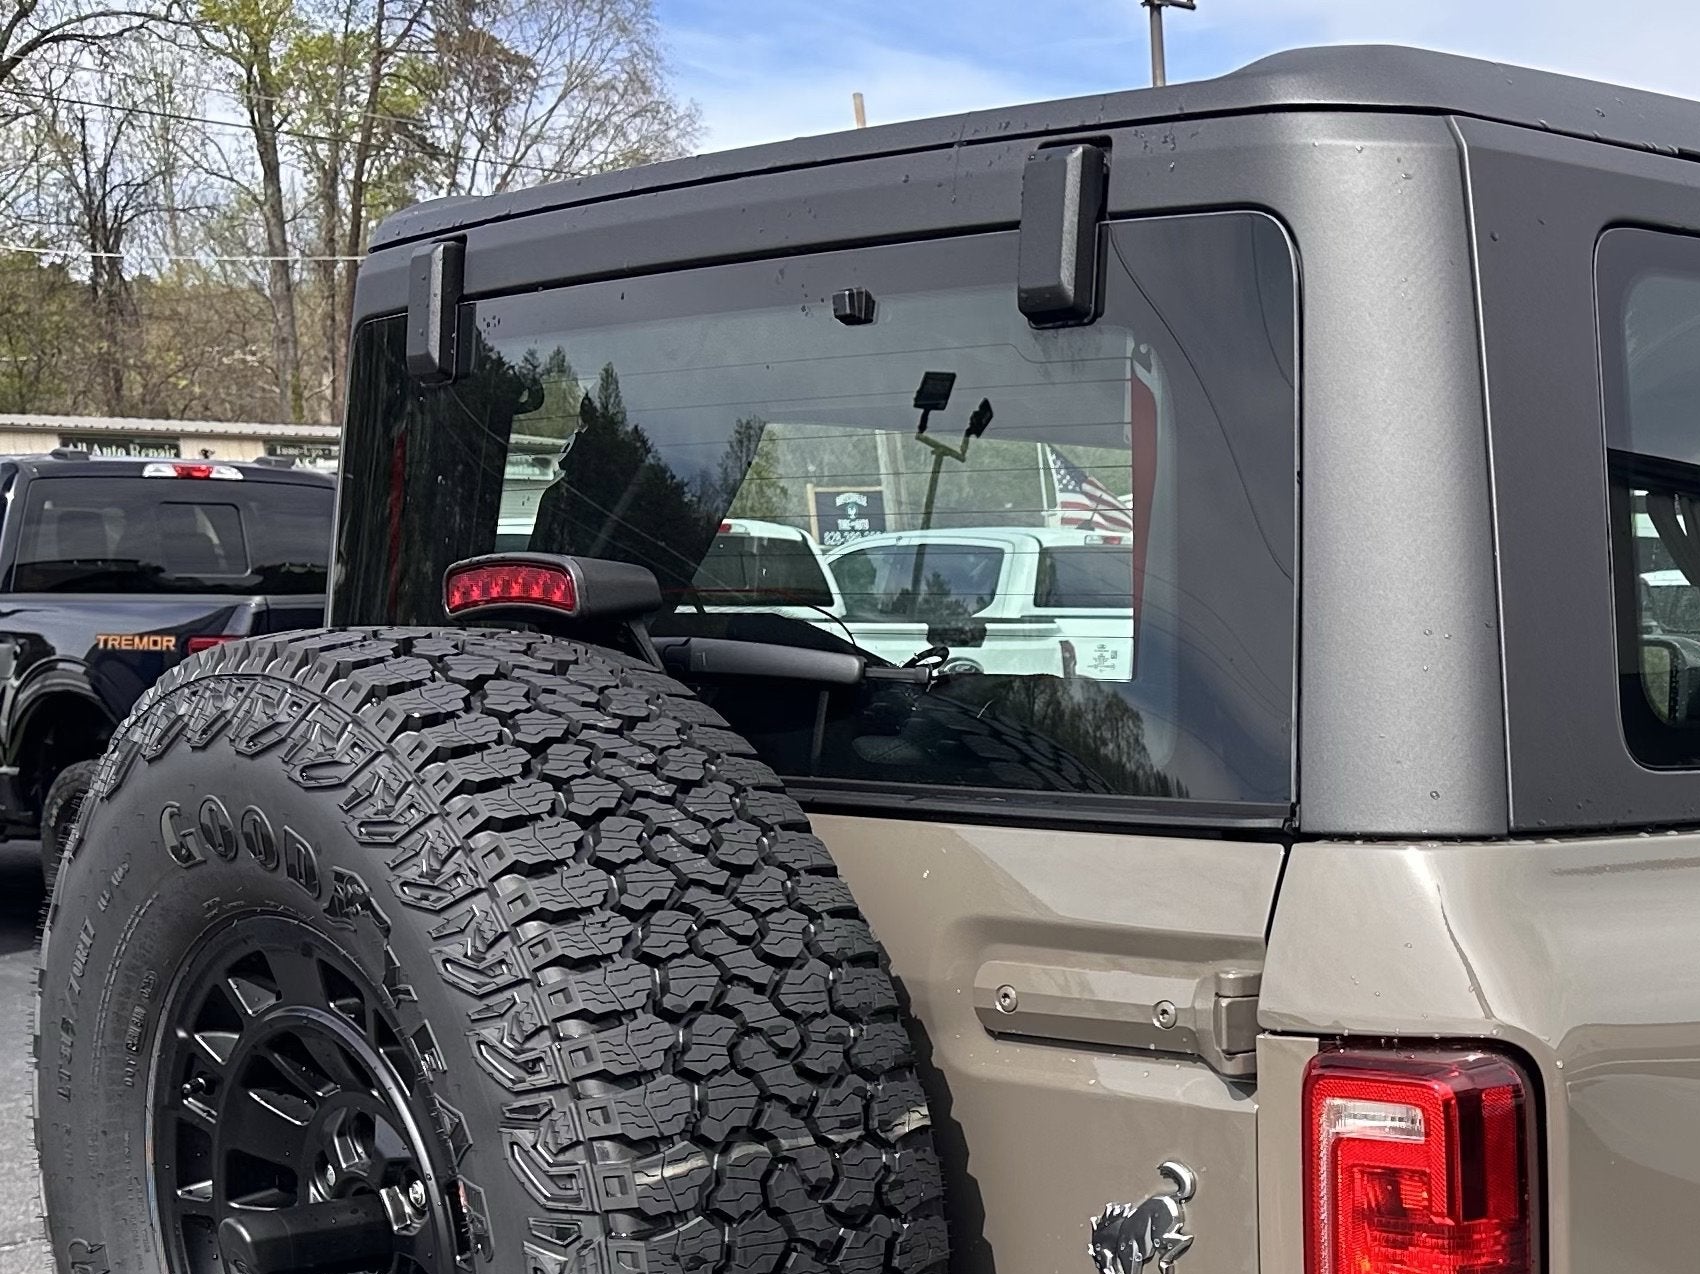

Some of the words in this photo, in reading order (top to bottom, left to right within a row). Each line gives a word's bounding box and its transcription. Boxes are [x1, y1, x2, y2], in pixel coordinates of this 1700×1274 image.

[92, 443, 126, 457] Auto
[130, 443, 177, 458] Repair
[96, 635, 177, 651] TREMOR
